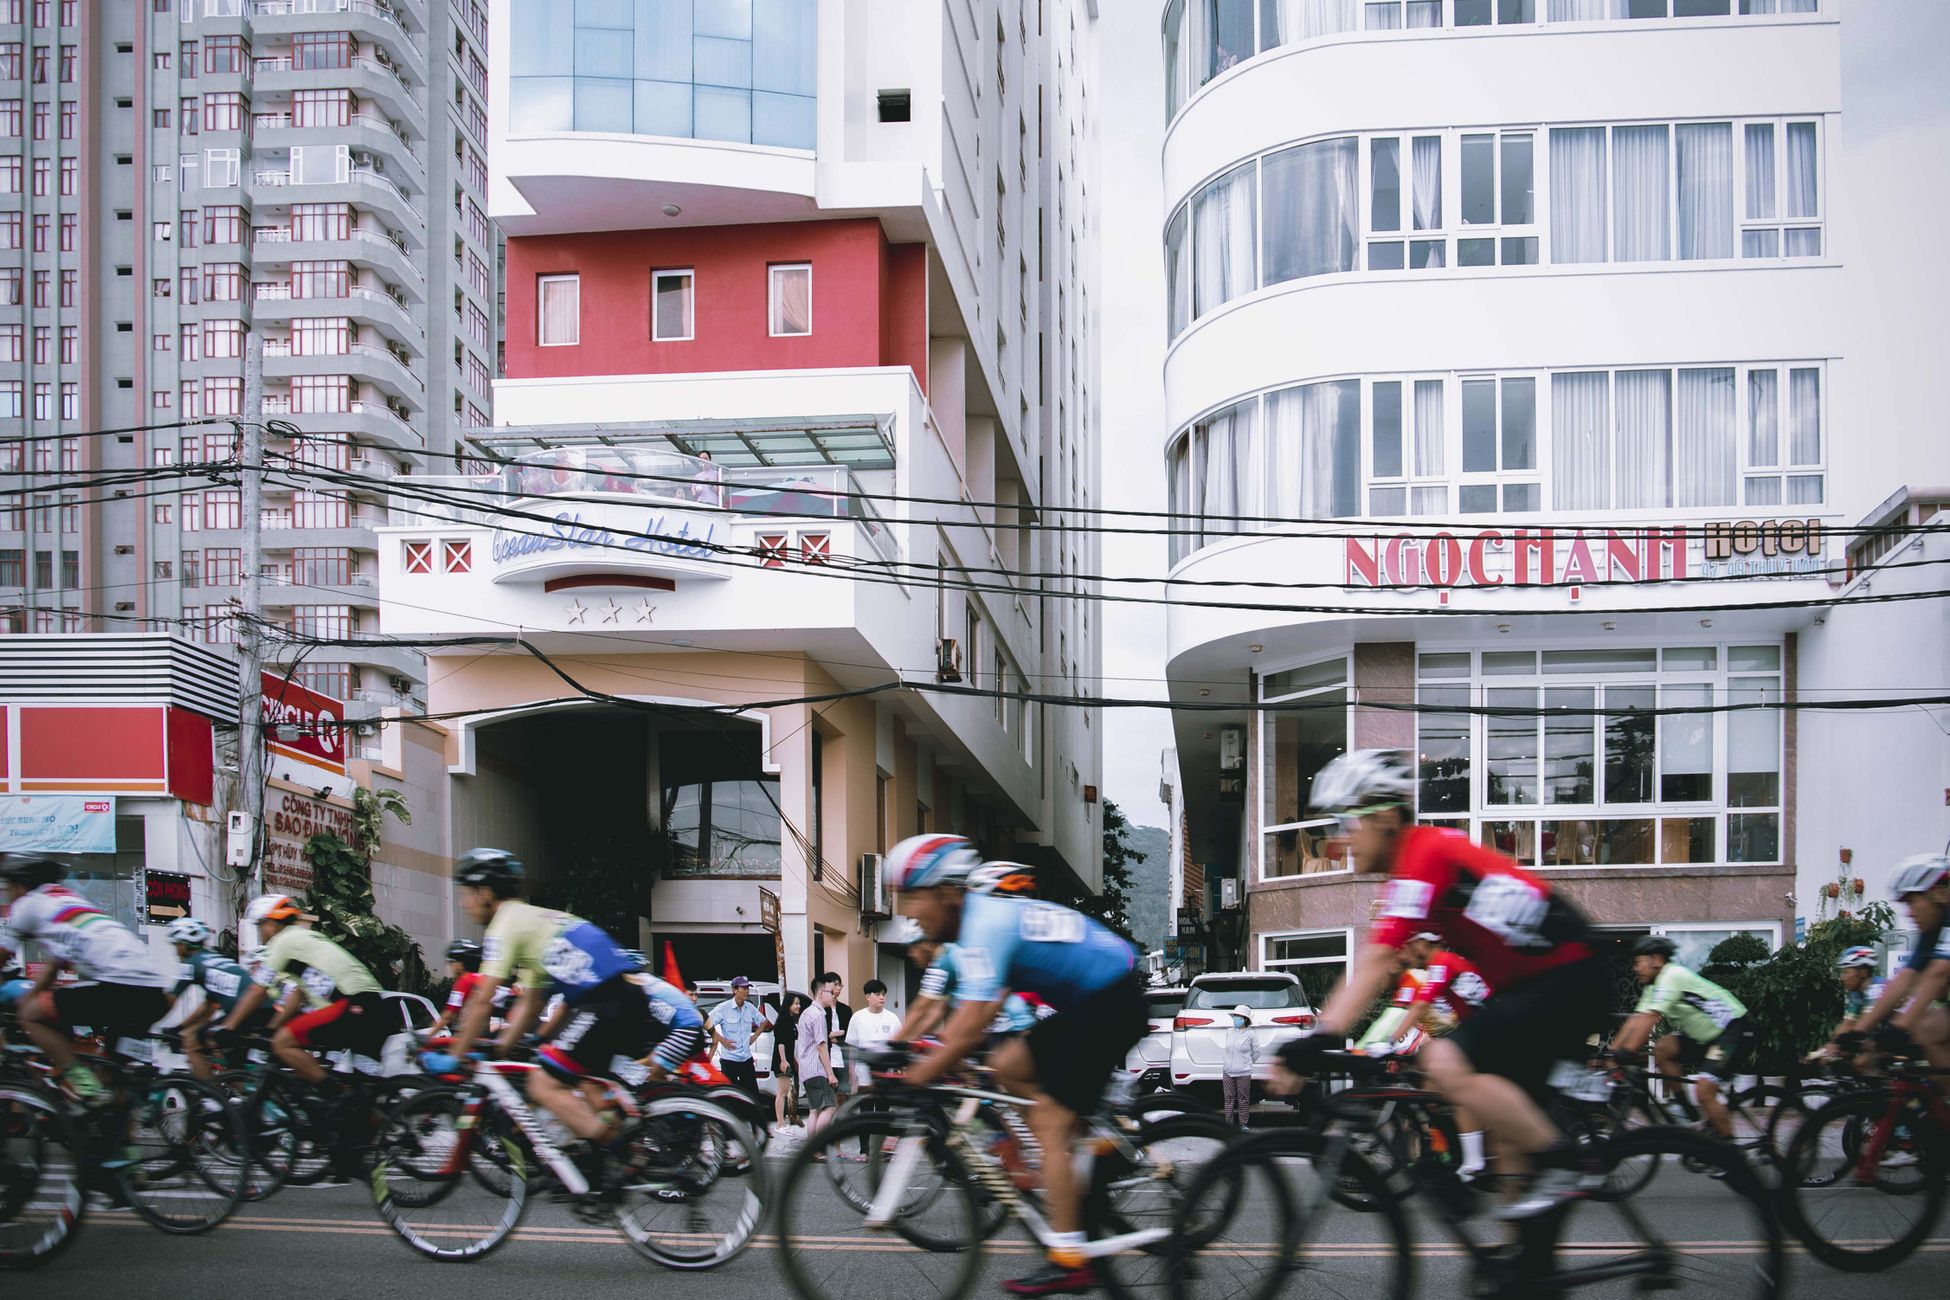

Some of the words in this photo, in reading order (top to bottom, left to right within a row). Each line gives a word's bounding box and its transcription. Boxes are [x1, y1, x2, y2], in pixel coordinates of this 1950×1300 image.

[493, 526, 548, 562] Ocean
[546, 512, 614, 551] Star
[624, 516, 715, 557] Hotel
[275, 812, 301, 836] SAO
[314, 804, 327, 822] TY
